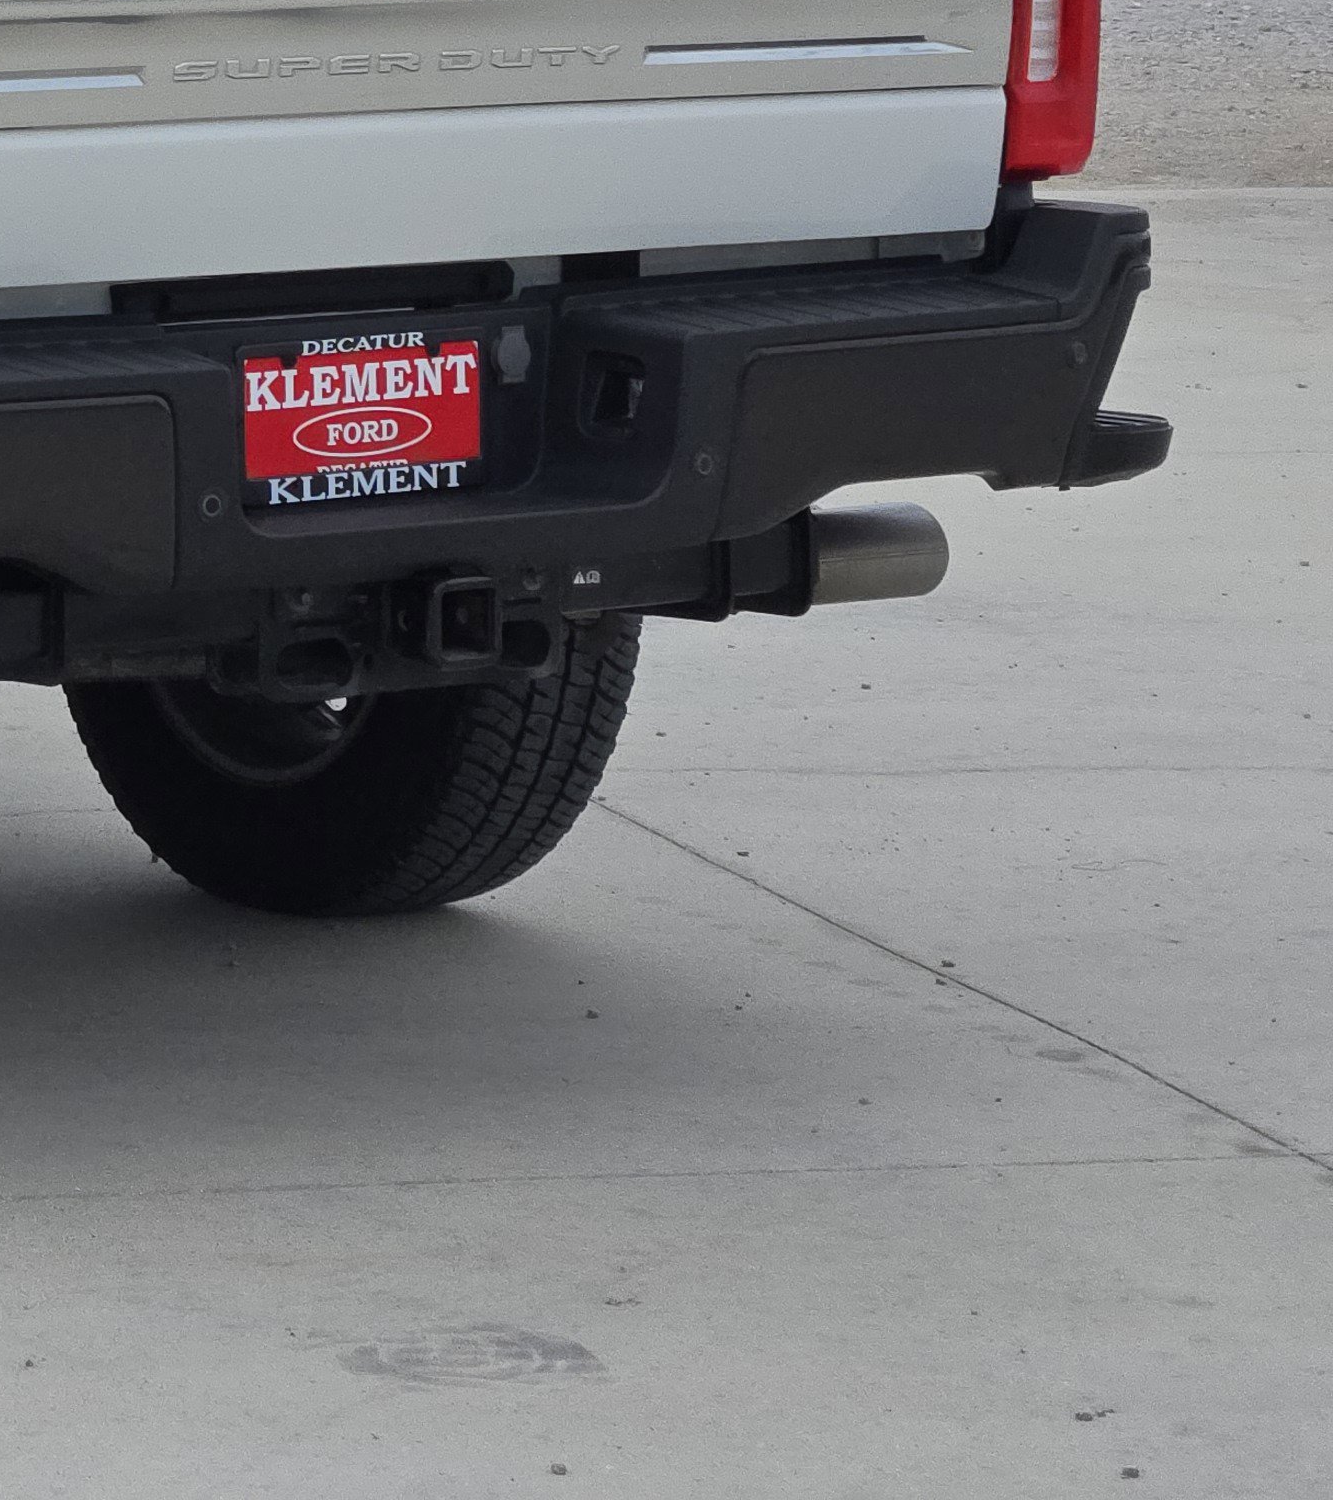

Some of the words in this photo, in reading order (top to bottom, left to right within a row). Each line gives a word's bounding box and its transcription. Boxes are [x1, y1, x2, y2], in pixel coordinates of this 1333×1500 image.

[172, 51, 421, 82] SUPER
[438, 44, 621, 71] DUTY
[301, 331, 426, 357] DECATUR
[245, 353, 478, 412] KLEMENT
[326, 418, 400, 446] FORD
[268, 460, 468, 506] KLEMENT
